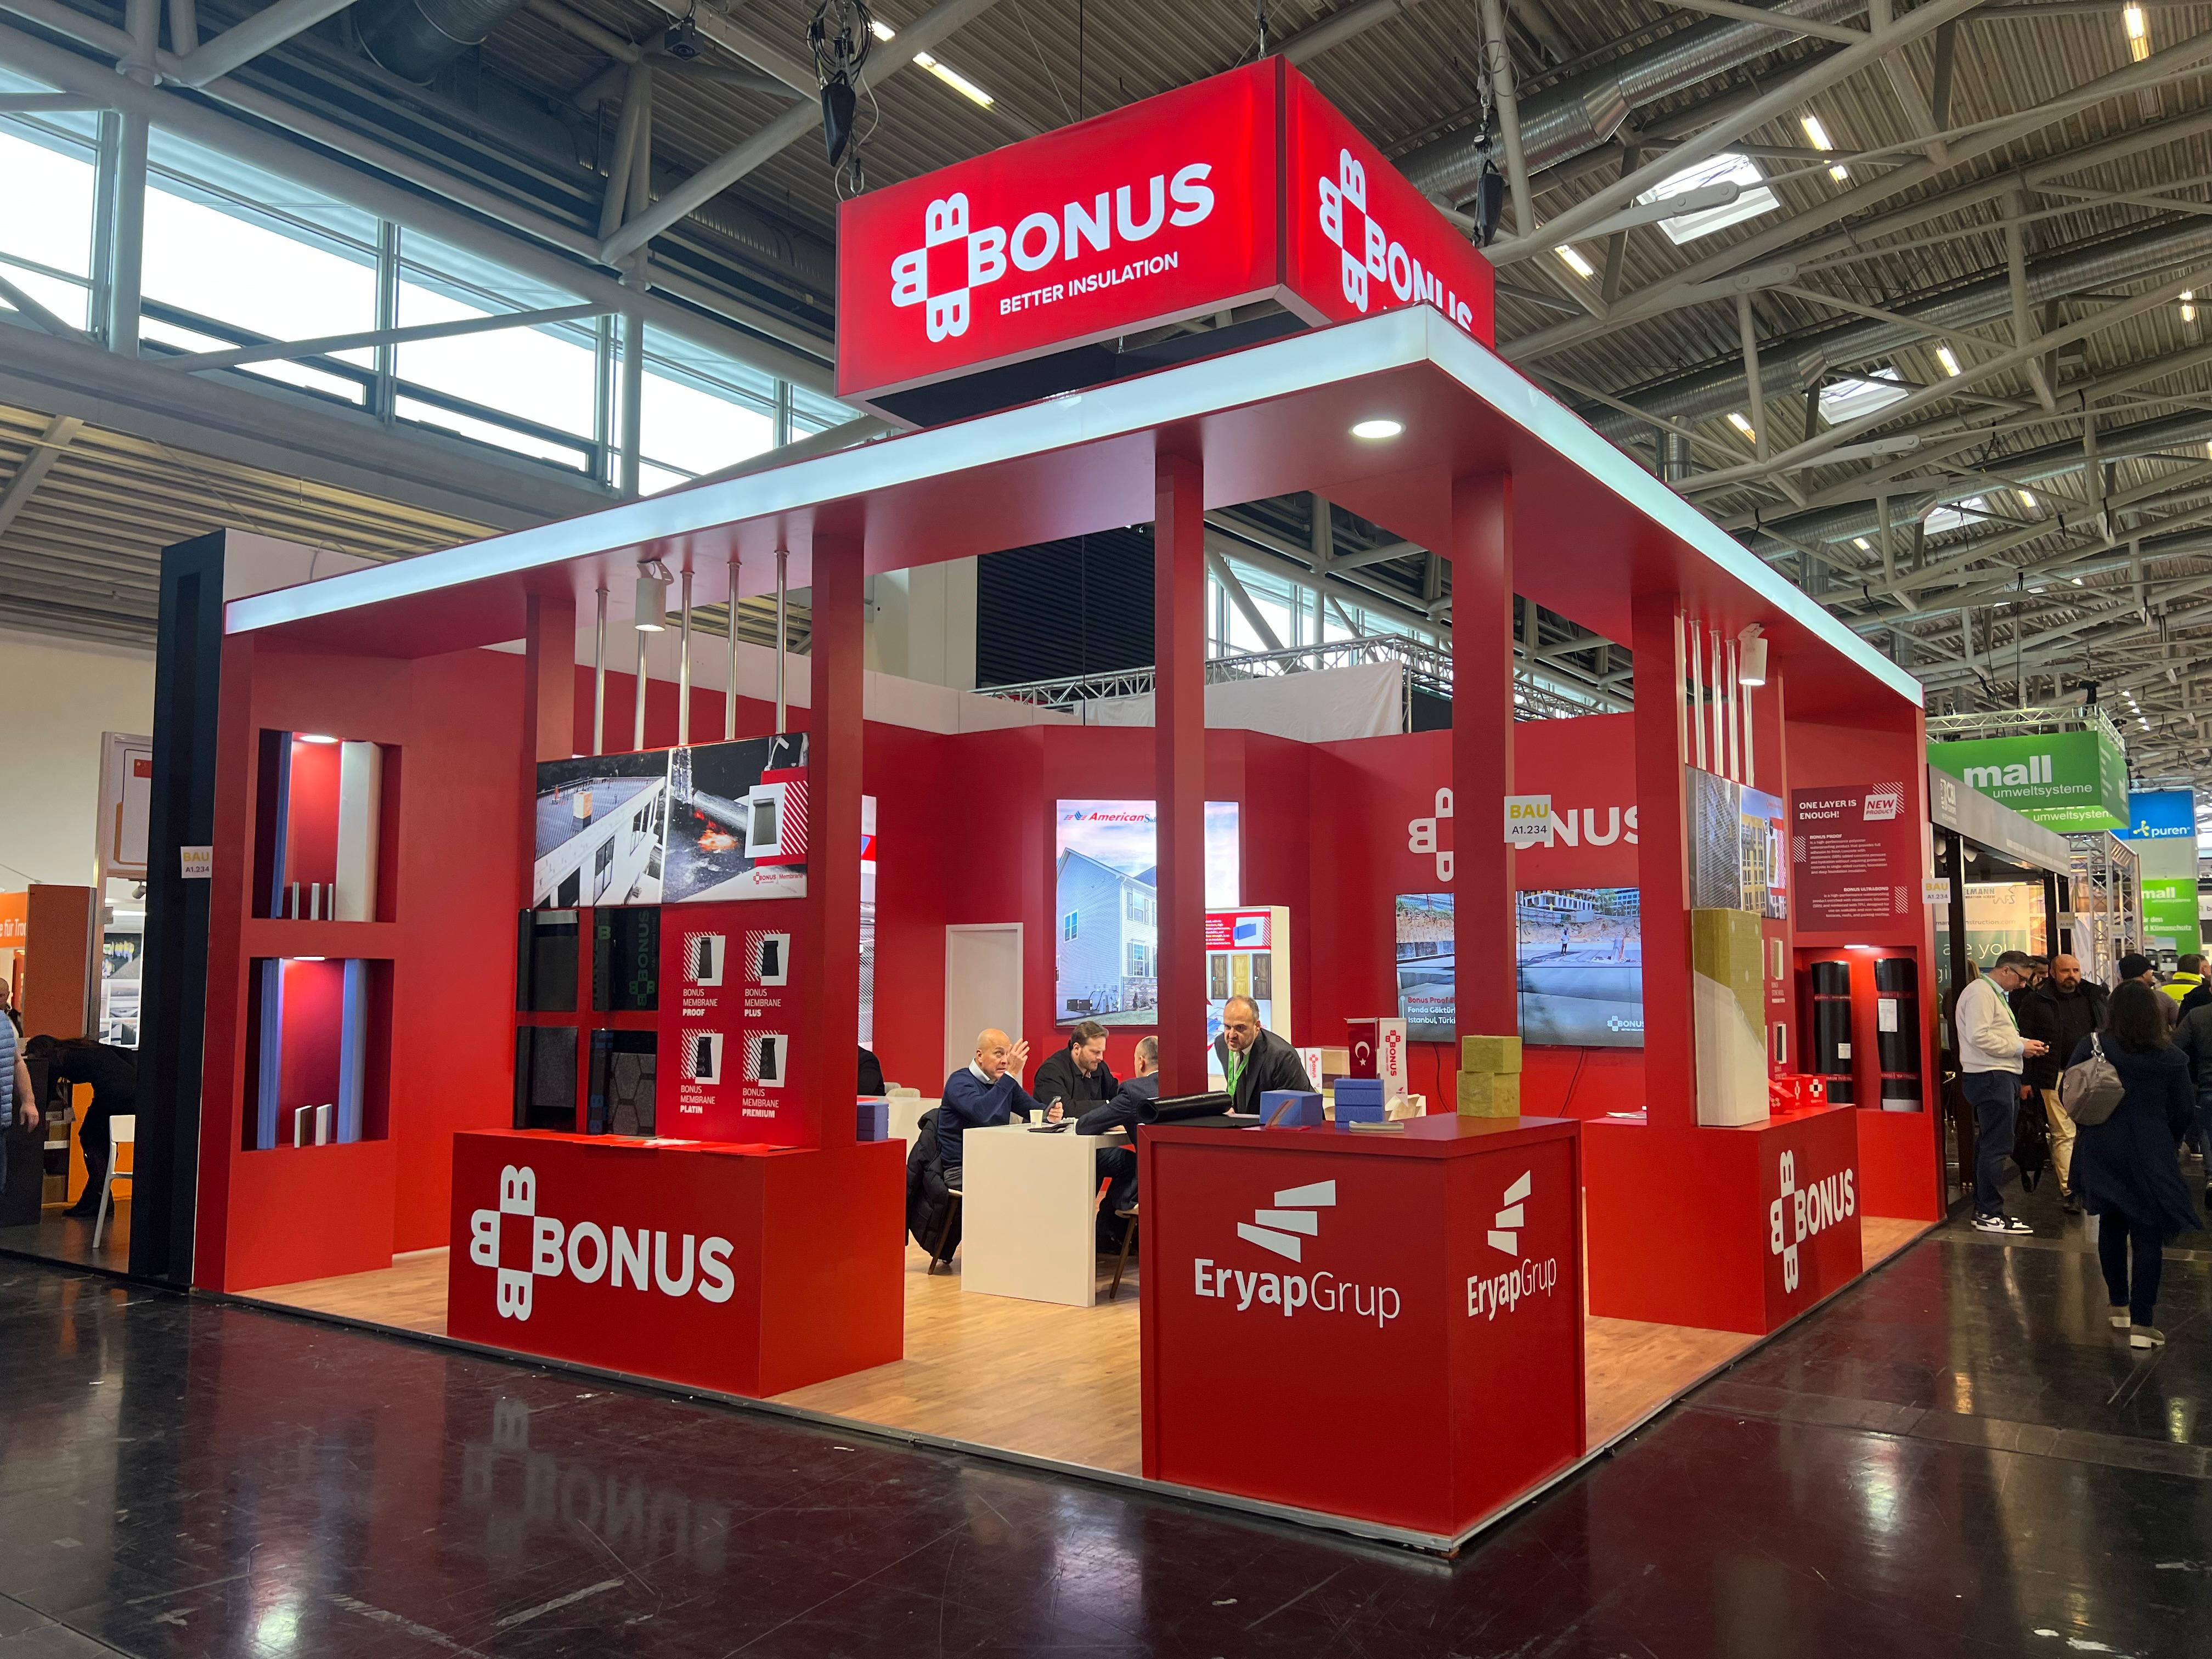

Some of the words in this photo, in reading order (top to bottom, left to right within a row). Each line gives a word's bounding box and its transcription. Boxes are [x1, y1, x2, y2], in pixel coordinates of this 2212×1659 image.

[968, 163, 1215, 288] BONUS
[1000, 281, 1064, 315] BETTER
[1068, 251, 1178, 297] INSULATION
[1963, 755, 2052, 788] mall
[1993, 784, 2093, 798] umweltsysteme
[1819, 800, 1847, 809] LAYER
[1867, 799, 1894, 809] NEW
[1510, 803, 1549, 819] BAU
[1799, 811, 1839, 820] ENOUGH!
[2033, 810, 2113, 821] umweltsystem
[1511, 825, 1548, 834] A1.234
[2152, 827, 2187, 837] puren
[183, 851, 210, 862] BAU
[1925, 883, 1949, 891] BAU
[2141, 887, 2176, 899] mall
[4, 919, 14, 937] für
[638, 910, 650, 981] BONUS
[683, 988, 704, 997] BONUS
[744, 988, 768, 997] BONUS
[682, 998, 718, 1007] MEMBRANE
[744, 998, 782, 1007] MEMBRANE
[682, 1008, 706, 1017] PROOF
[744, 1009, 762, 1017] PLUS
[1408, 1017, 1437, 1025] Istanbul,
[680, 1085, 702, 1094] BONUS
[742, 1087, 765, 1097] BONUS
[680, 1094, 716, 1104] MEMBRANE
[742, 1098, 780, 1108] MEMBRANE
[680, 1105, 703, 1114] PLATIN
[742, 1108, 776, 1118] PREMIUM
[1794, 1168, 1856, 1244] BONUS
[532, 1215, 735, 1304] BONUS
[1194, 1257, 1401, 1329] EryapGrup
[1467, 1256, 1557, 1322] EryapGrup
